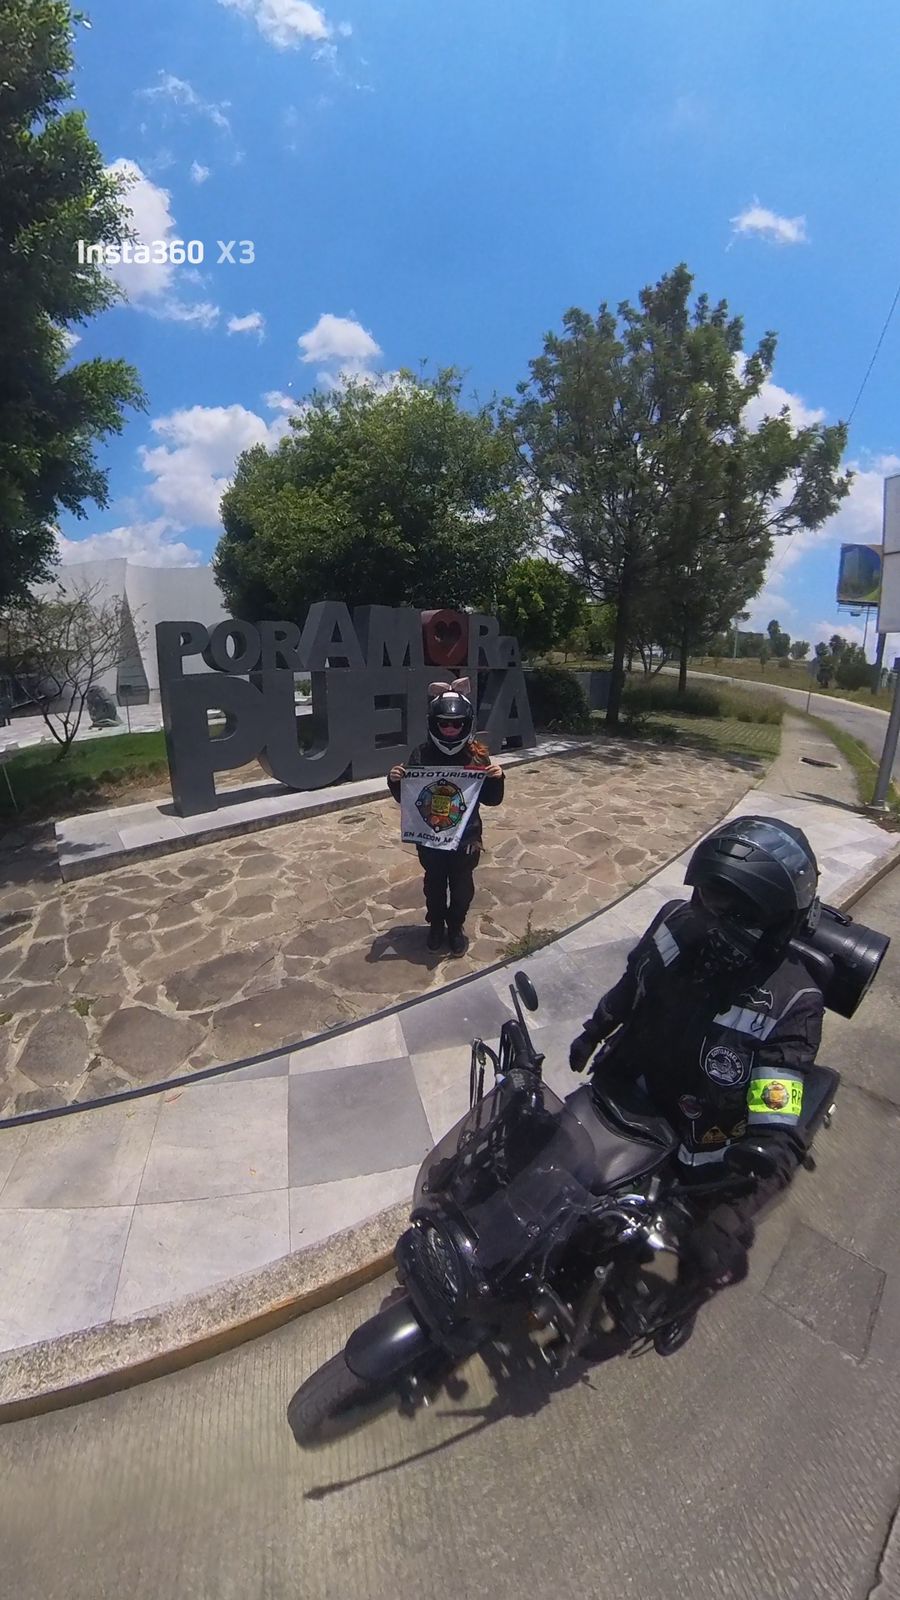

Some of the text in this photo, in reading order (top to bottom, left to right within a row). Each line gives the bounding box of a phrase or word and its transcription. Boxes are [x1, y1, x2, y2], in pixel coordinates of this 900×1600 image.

[156, 618, 300, 681] POR
[161, 668, 536, 817] PUEA
[404, 771, 486, 780] MOTOTURISMO
